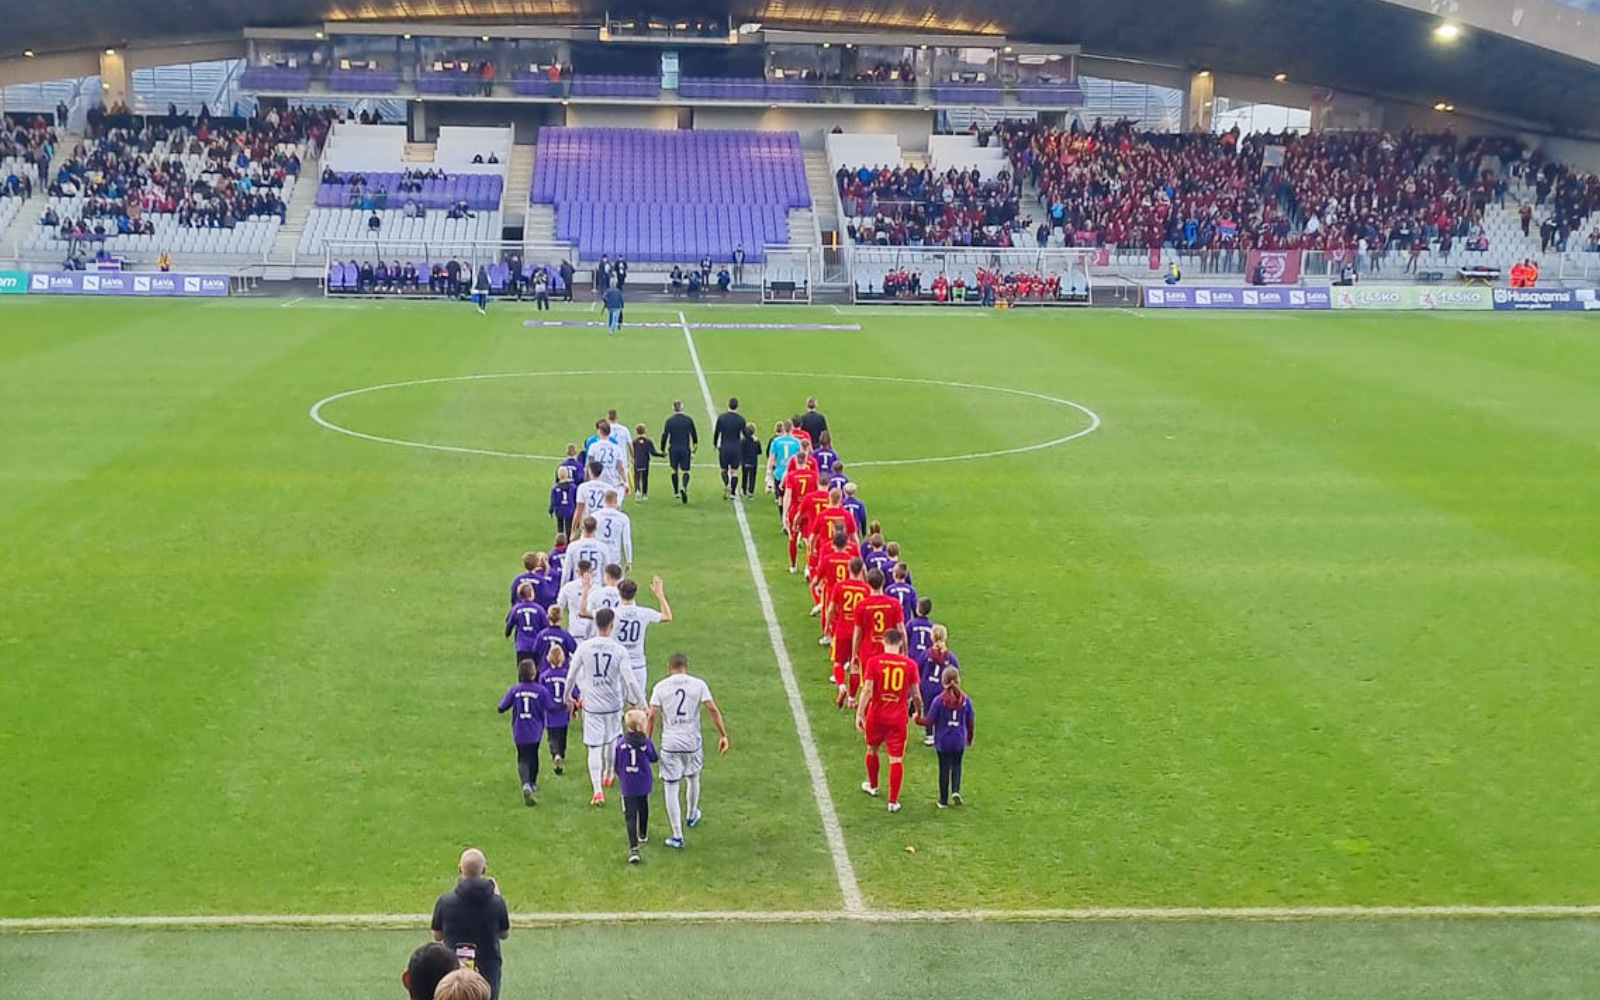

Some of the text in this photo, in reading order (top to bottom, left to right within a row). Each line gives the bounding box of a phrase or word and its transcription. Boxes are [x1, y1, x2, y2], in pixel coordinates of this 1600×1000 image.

[600, 447, 614, 464] 23
[798, 479, 807, 495] 7
[588, 490, 605, 509] 32
[603, 518, 612, 538] 3
[836, 565, 846, 583] 9
[617, 619, 641, 643] 30
[873, 611, 884, 633] 3
[593, 653, 612, 679] 17
[882, 666, 904, 691] 10
[675, 688, 687, 716] 2
